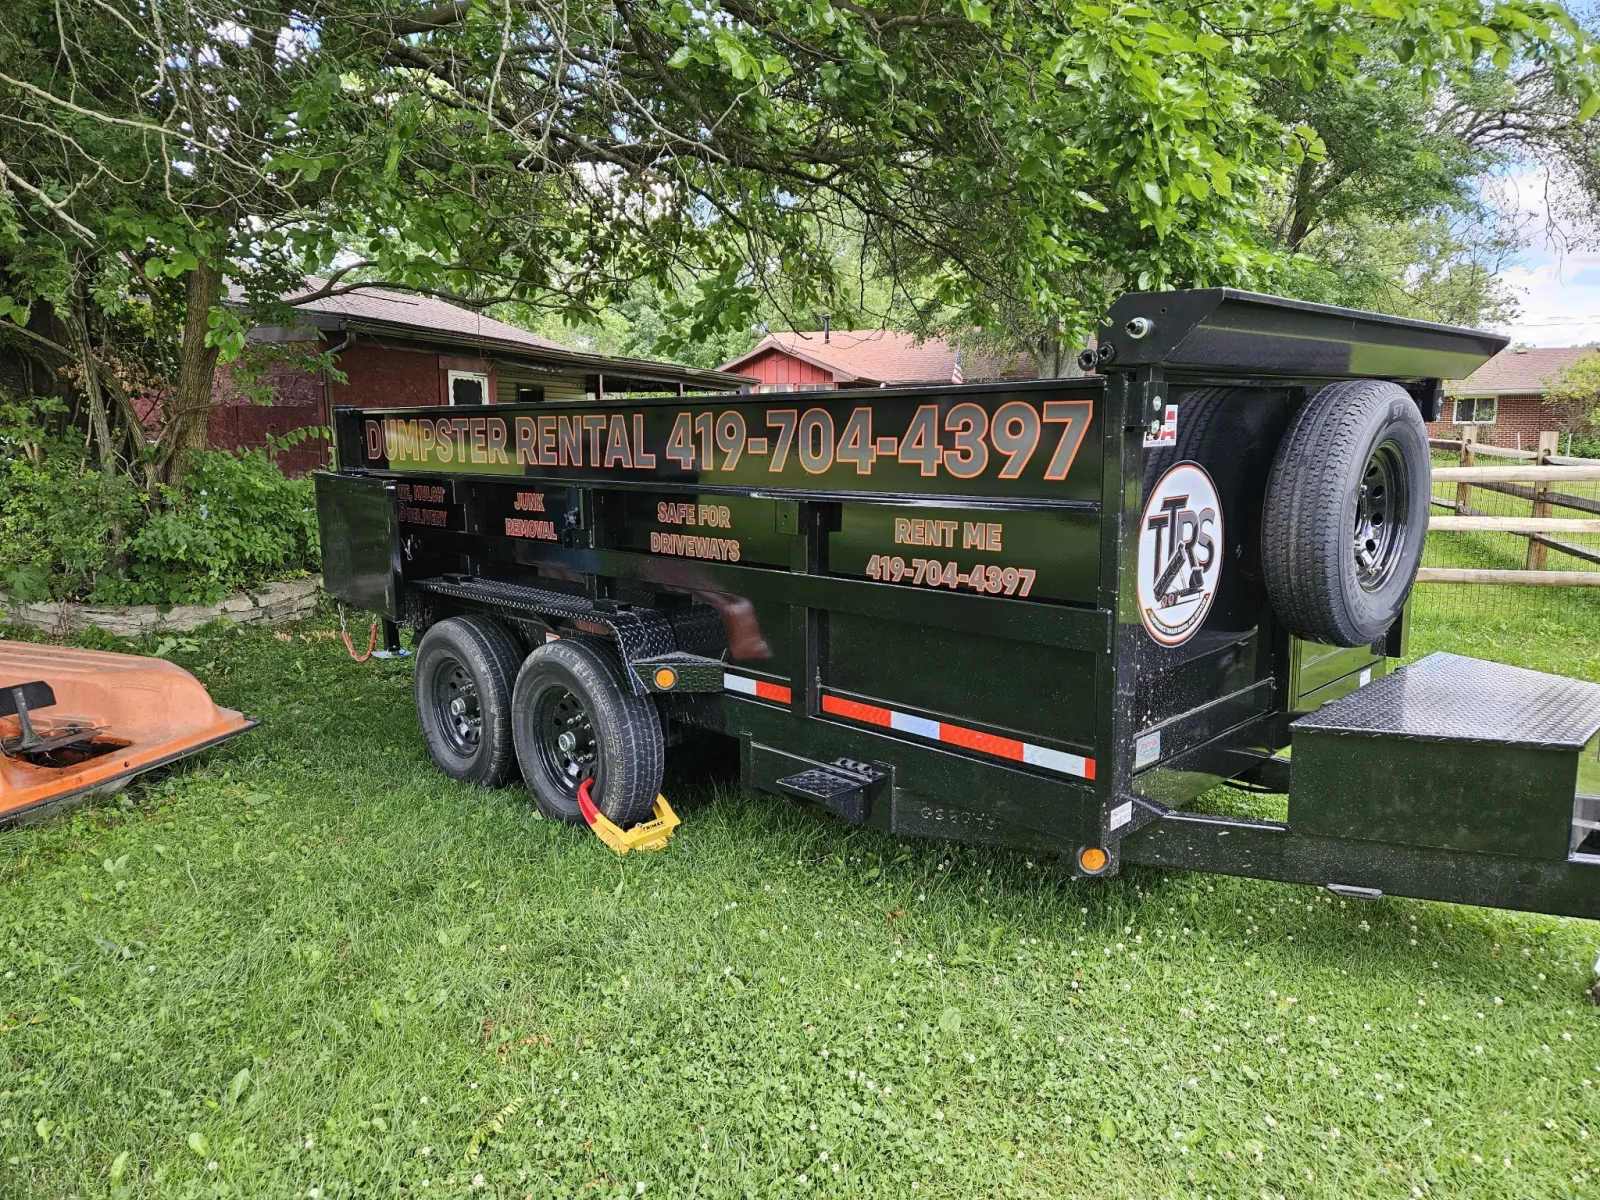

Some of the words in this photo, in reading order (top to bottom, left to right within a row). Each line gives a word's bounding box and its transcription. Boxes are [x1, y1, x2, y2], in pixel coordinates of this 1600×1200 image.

[365, 417, 509, 465] DUMPSTER
[515, 413, 656, 470] RENTAL
[665, 400, 1094, 481] 419-704-4397
[413, 485, 445, 503] MULCH
[514, 492, 545, 513] JUNK
[406, 507, 447, 527] DELIVERY
[657, 501, 696, 526] SAFE
[698, 503, 731, 528] FOR
[505, 517, 558, 541] REMOVAL
[894, 517, 958, 549] RENT
[962, 521, 1002, 552] ME
[650, 531, 741, 562] DRIVEWAYS
[865, 554, 1036, 597] 419-704-4397
[642, 820, 664, 831] TRIMAX
